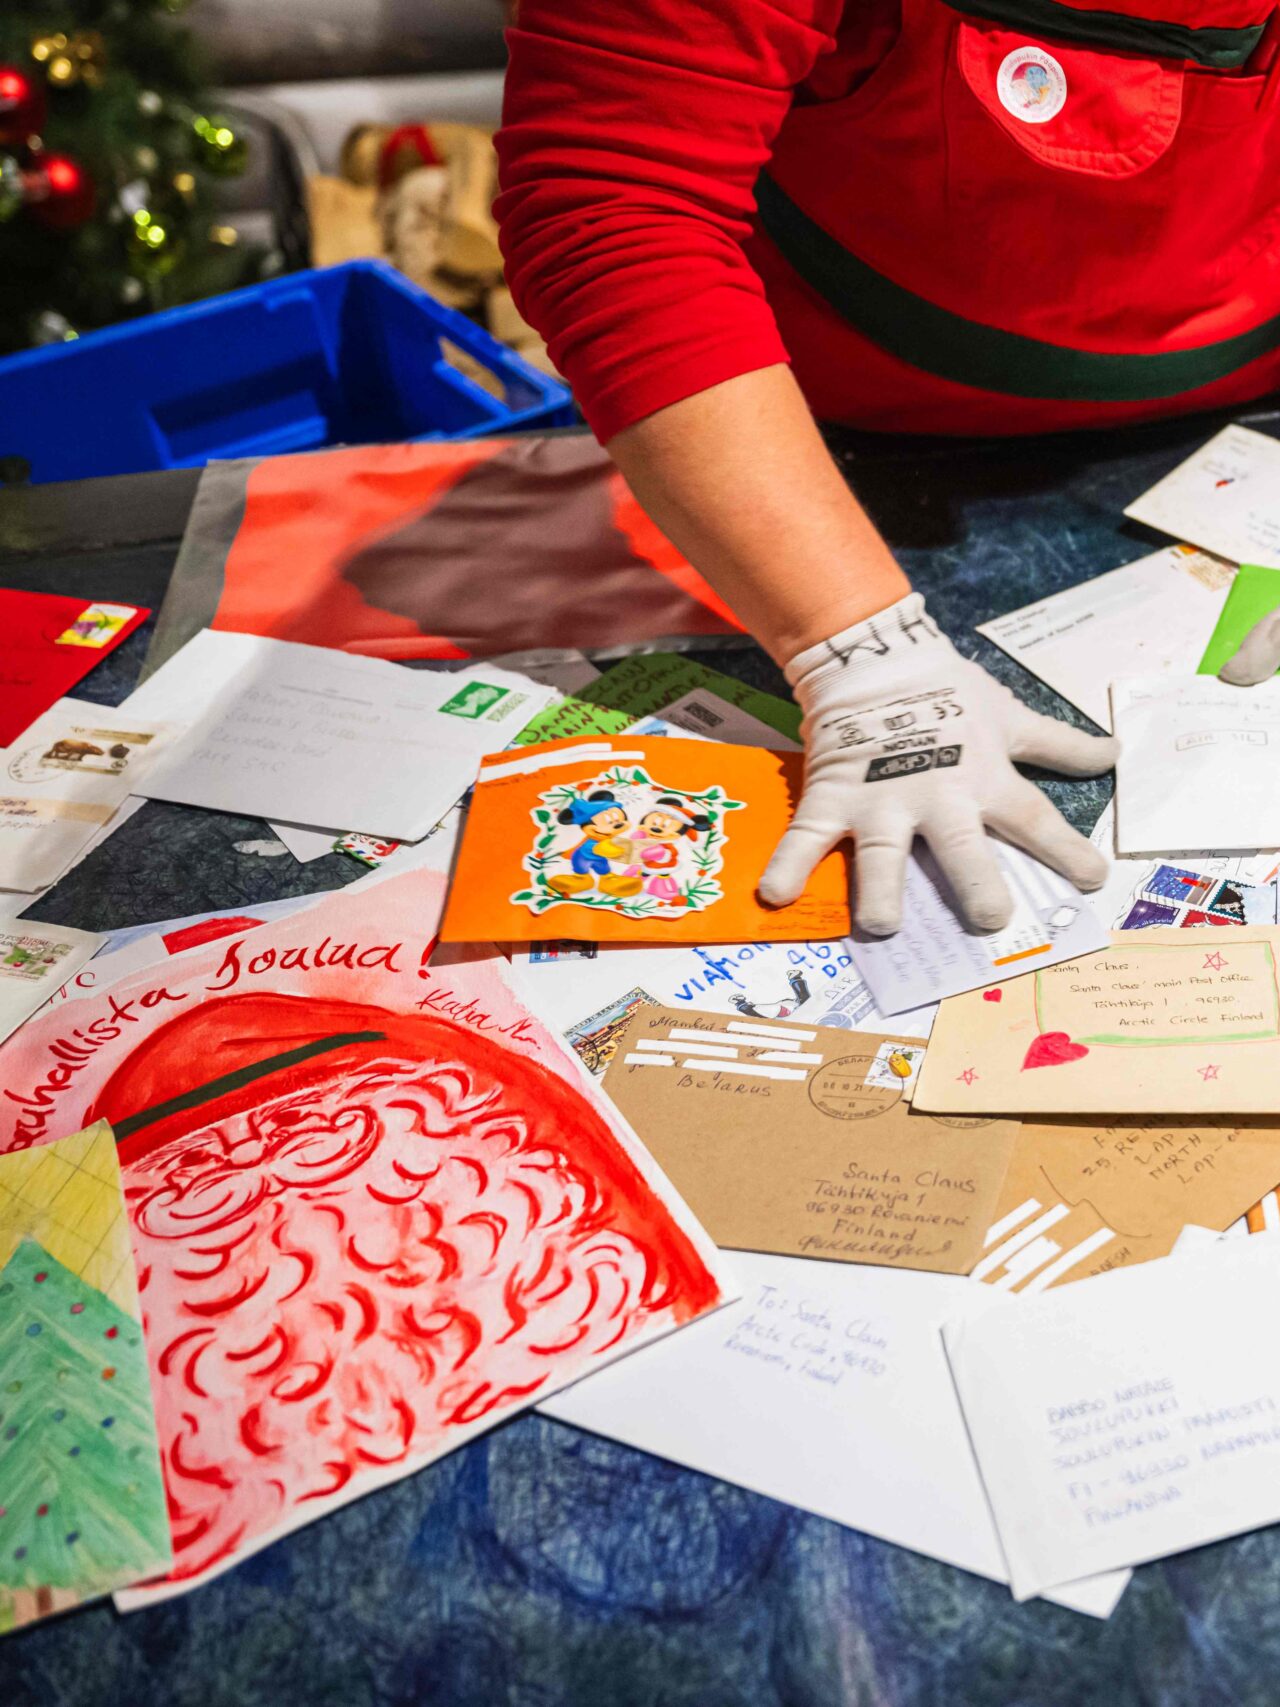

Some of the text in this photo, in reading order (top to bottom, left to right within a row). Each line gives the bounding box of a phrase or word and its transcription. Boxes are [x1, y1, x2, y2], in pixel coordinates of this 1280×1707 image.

[882, 735, 938, 752] NYLON
[1069, 983, 1102, 993] Santa
[1118, 1010, 1265, 1027] Arctic Circle Finland
[1148, 1132, 1203, 1181] NORTH
[842, 1161, 977, 1194] Santa Claus
[870, 1204, 971, 1227] Rovaniemi
[832, 1217, 918, 1242] Finland
